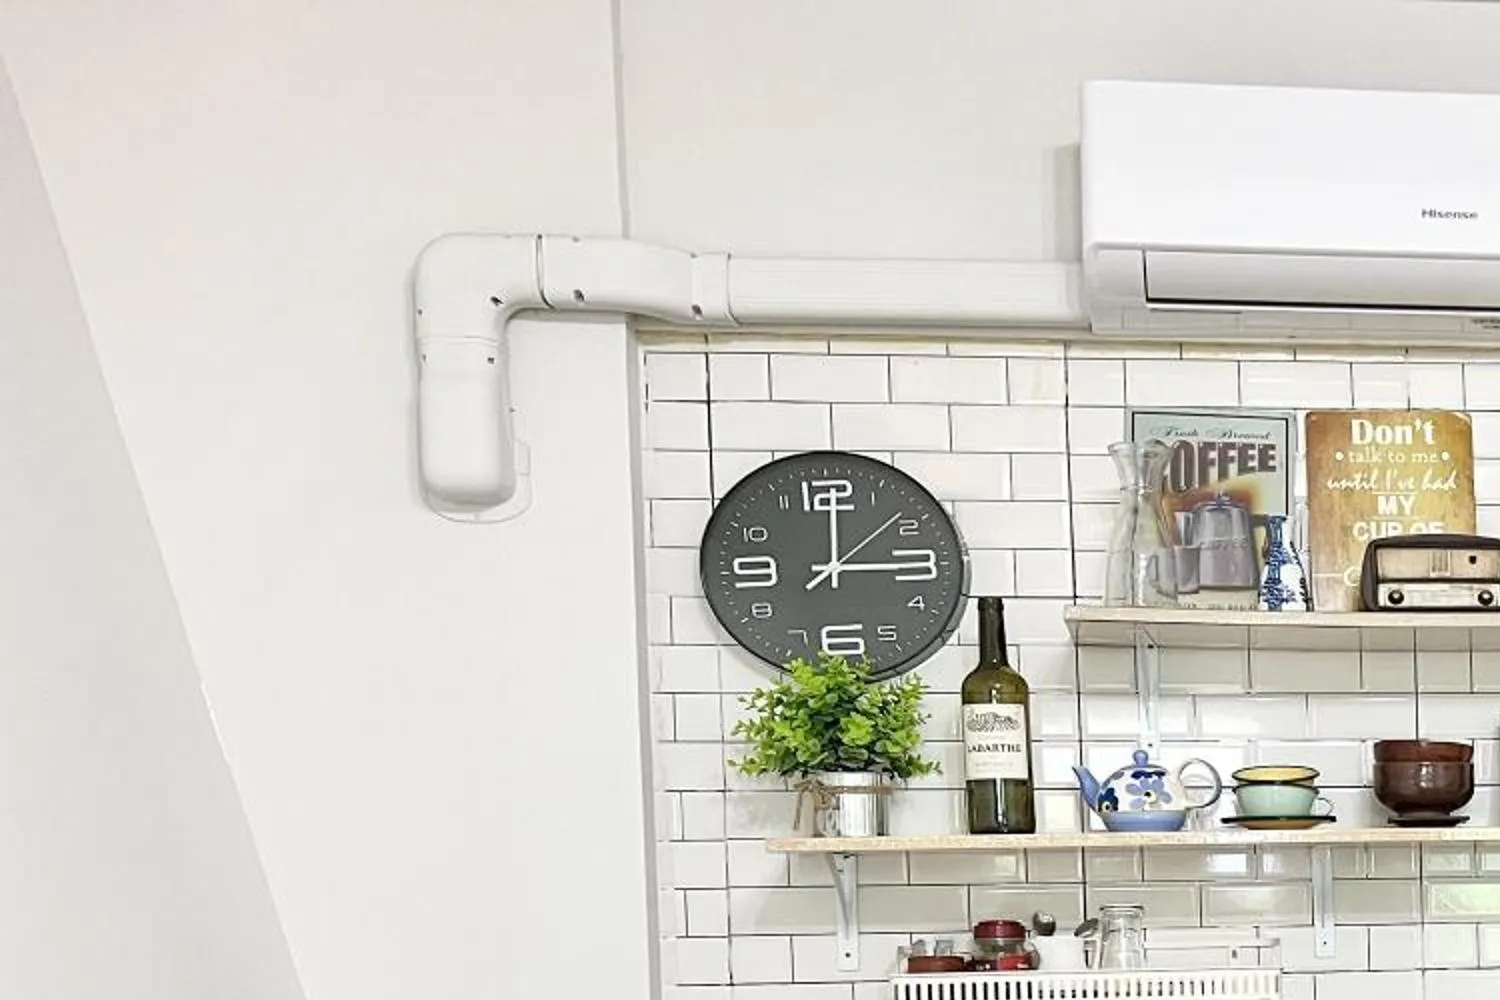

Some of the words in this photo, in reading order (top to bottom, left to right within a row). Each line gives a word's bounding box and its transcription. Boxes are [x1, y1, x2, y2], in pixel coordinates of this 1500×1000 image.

[1421, 208, 1478, 219] Hisense
[1351, 419, 1437, 445] Don't
[1349, 447, 1382, 463] talk
[1387, 449, 1406, 463] to
[1412, 452, 1440, 463] me
[1148, 440, 1277, 493] OFFEE
[1327, 469, 1377, 490] until
[1385, 468, 1416, 491] I've
[1421, 467, 1457, 491] had
[801, 479, 855, 512] 12
[1377, 496, 1416, 516] MY
[743, 526, 768, 542] 10
[899, 519, 919, 535] 2
[733, 555, 778, 589] 9
[892, 549, 938, 581] 3
[751, 602, 772, 618] 8
[907, 595, 926, 610] 4
[787, 629, 808, 645] 7
[821, 623, 865, 655] 6
[877, 625, 897, 641] 5
